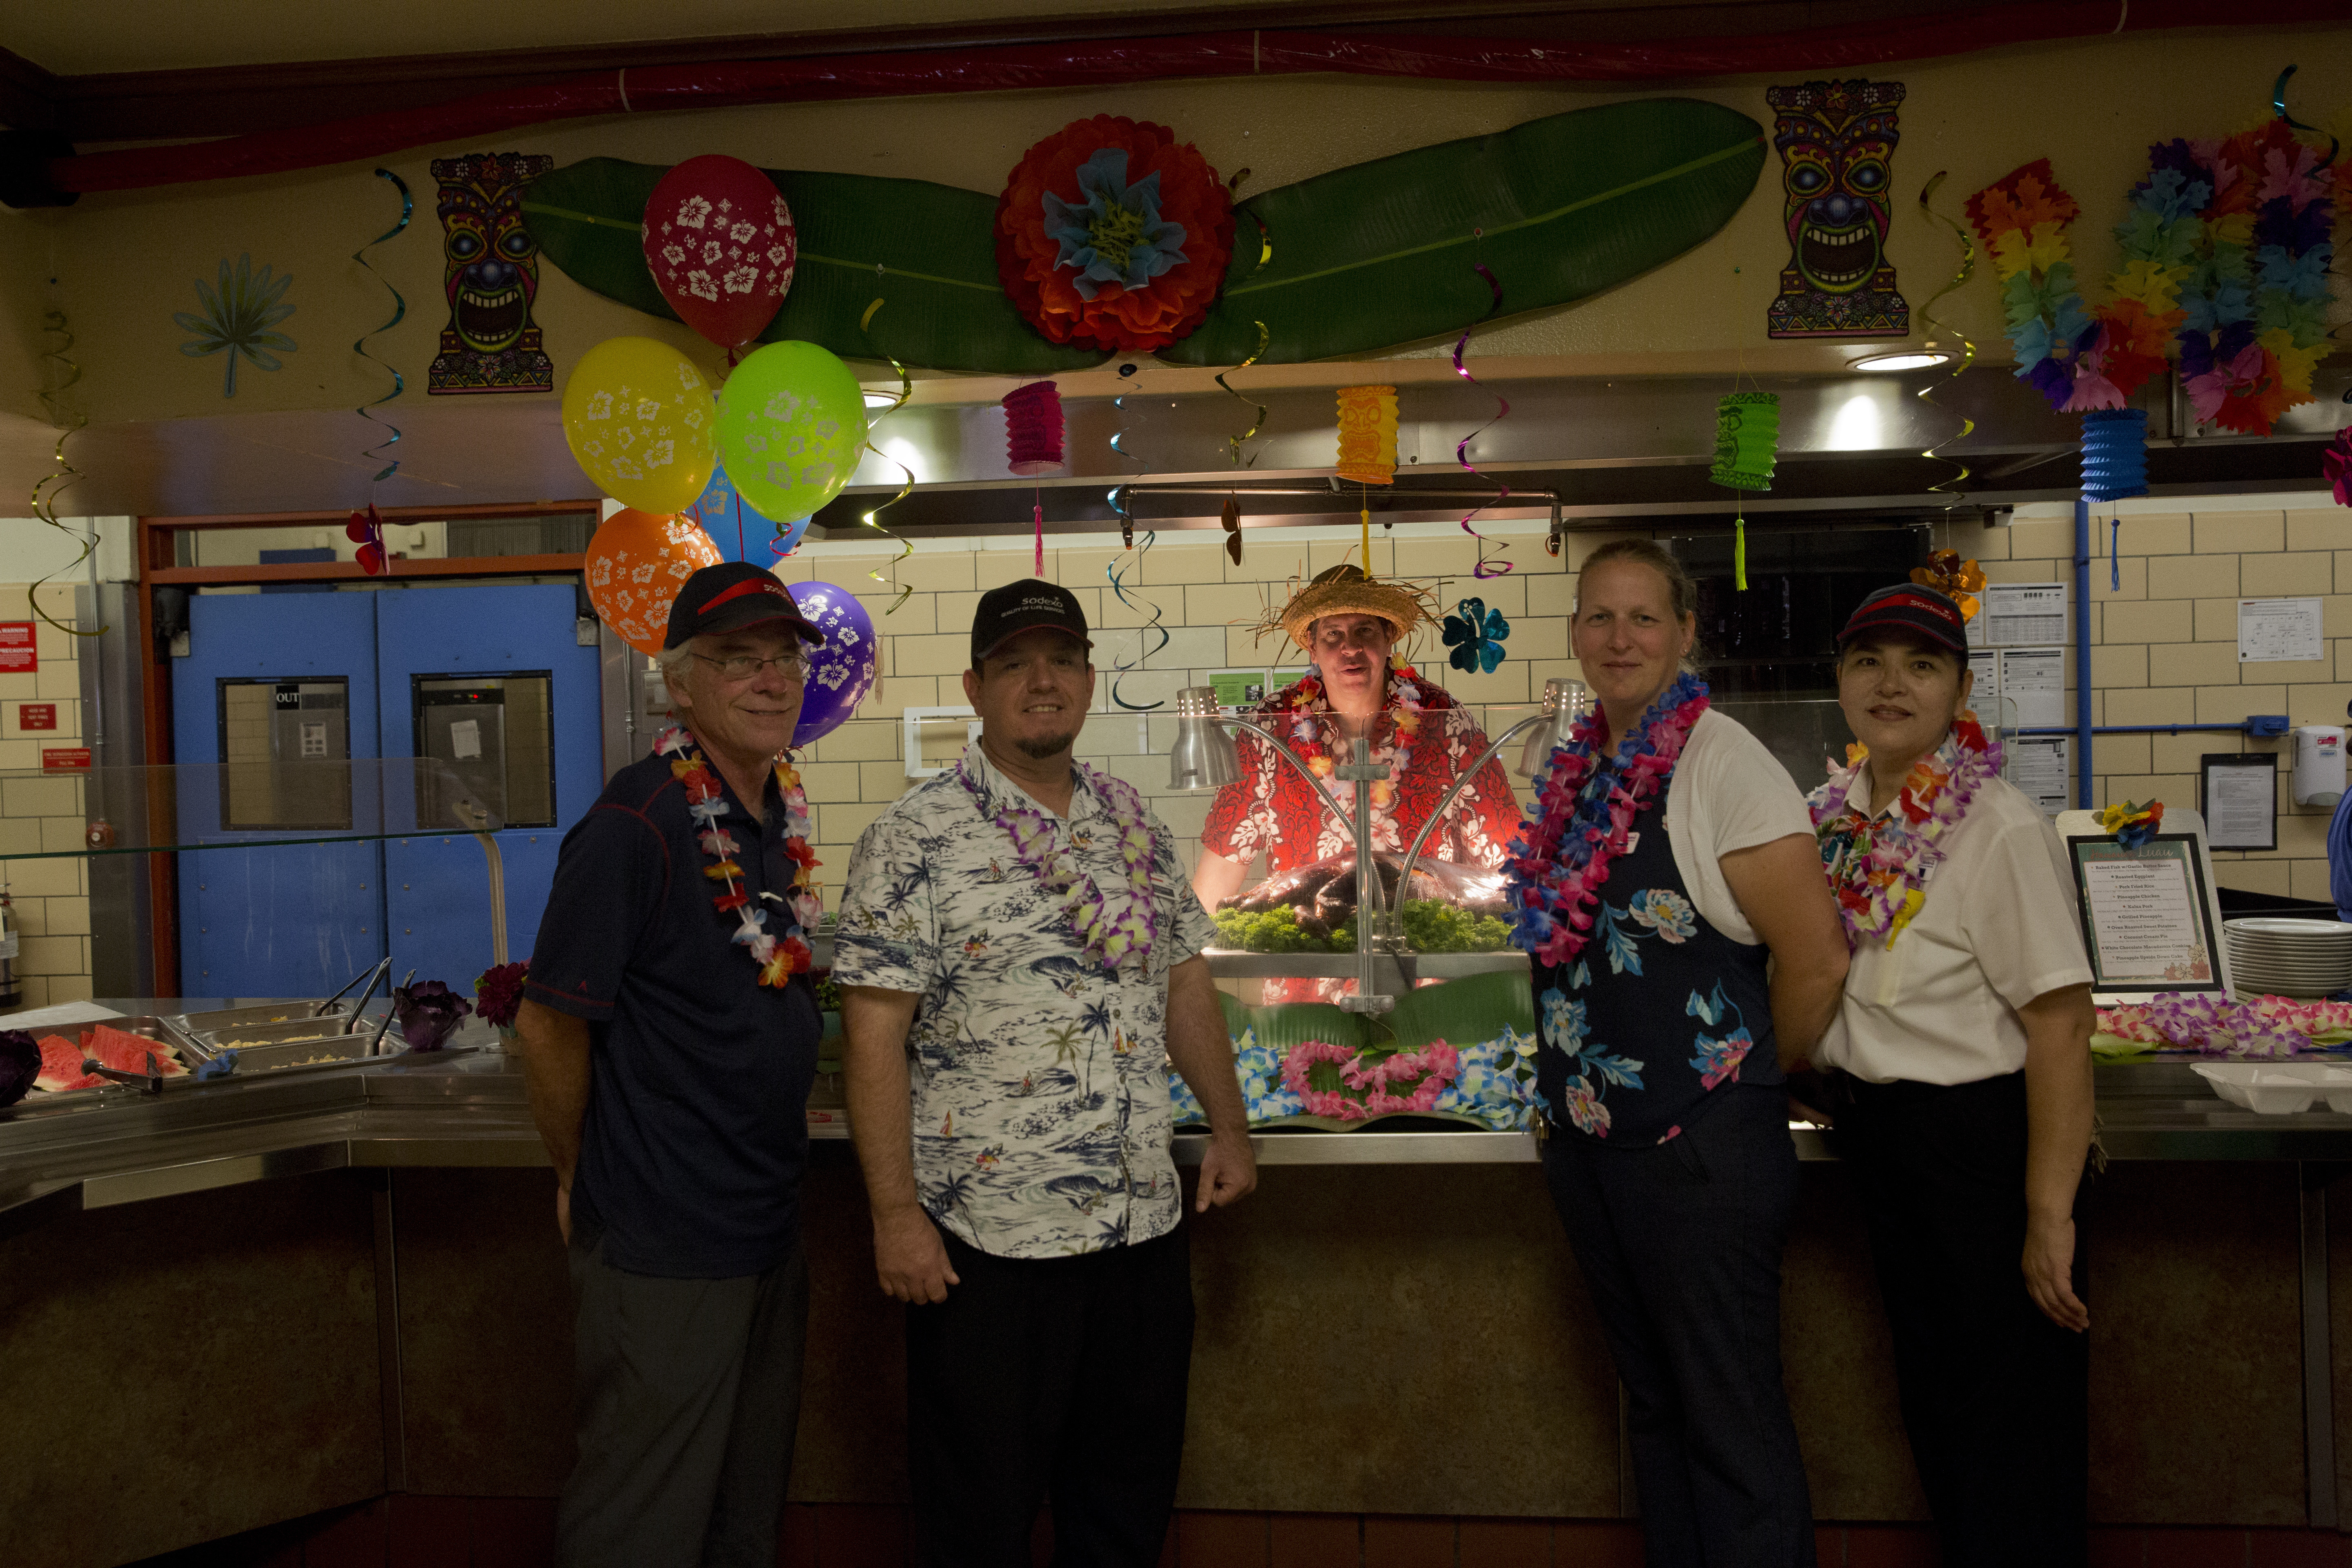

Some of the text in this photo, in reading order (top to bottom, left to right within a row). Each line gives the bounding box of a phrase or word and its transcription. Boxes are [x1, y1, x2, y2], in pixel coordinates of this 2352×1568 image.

[1022, 596, 1063, 608] sodexo
[1001, 607, 1021, 617] QUALITY
[1909, 599, 1953, 620] sodexo
[276, 693, 300, 703] OUT
[2138, 846, 2174, 857] Luau
